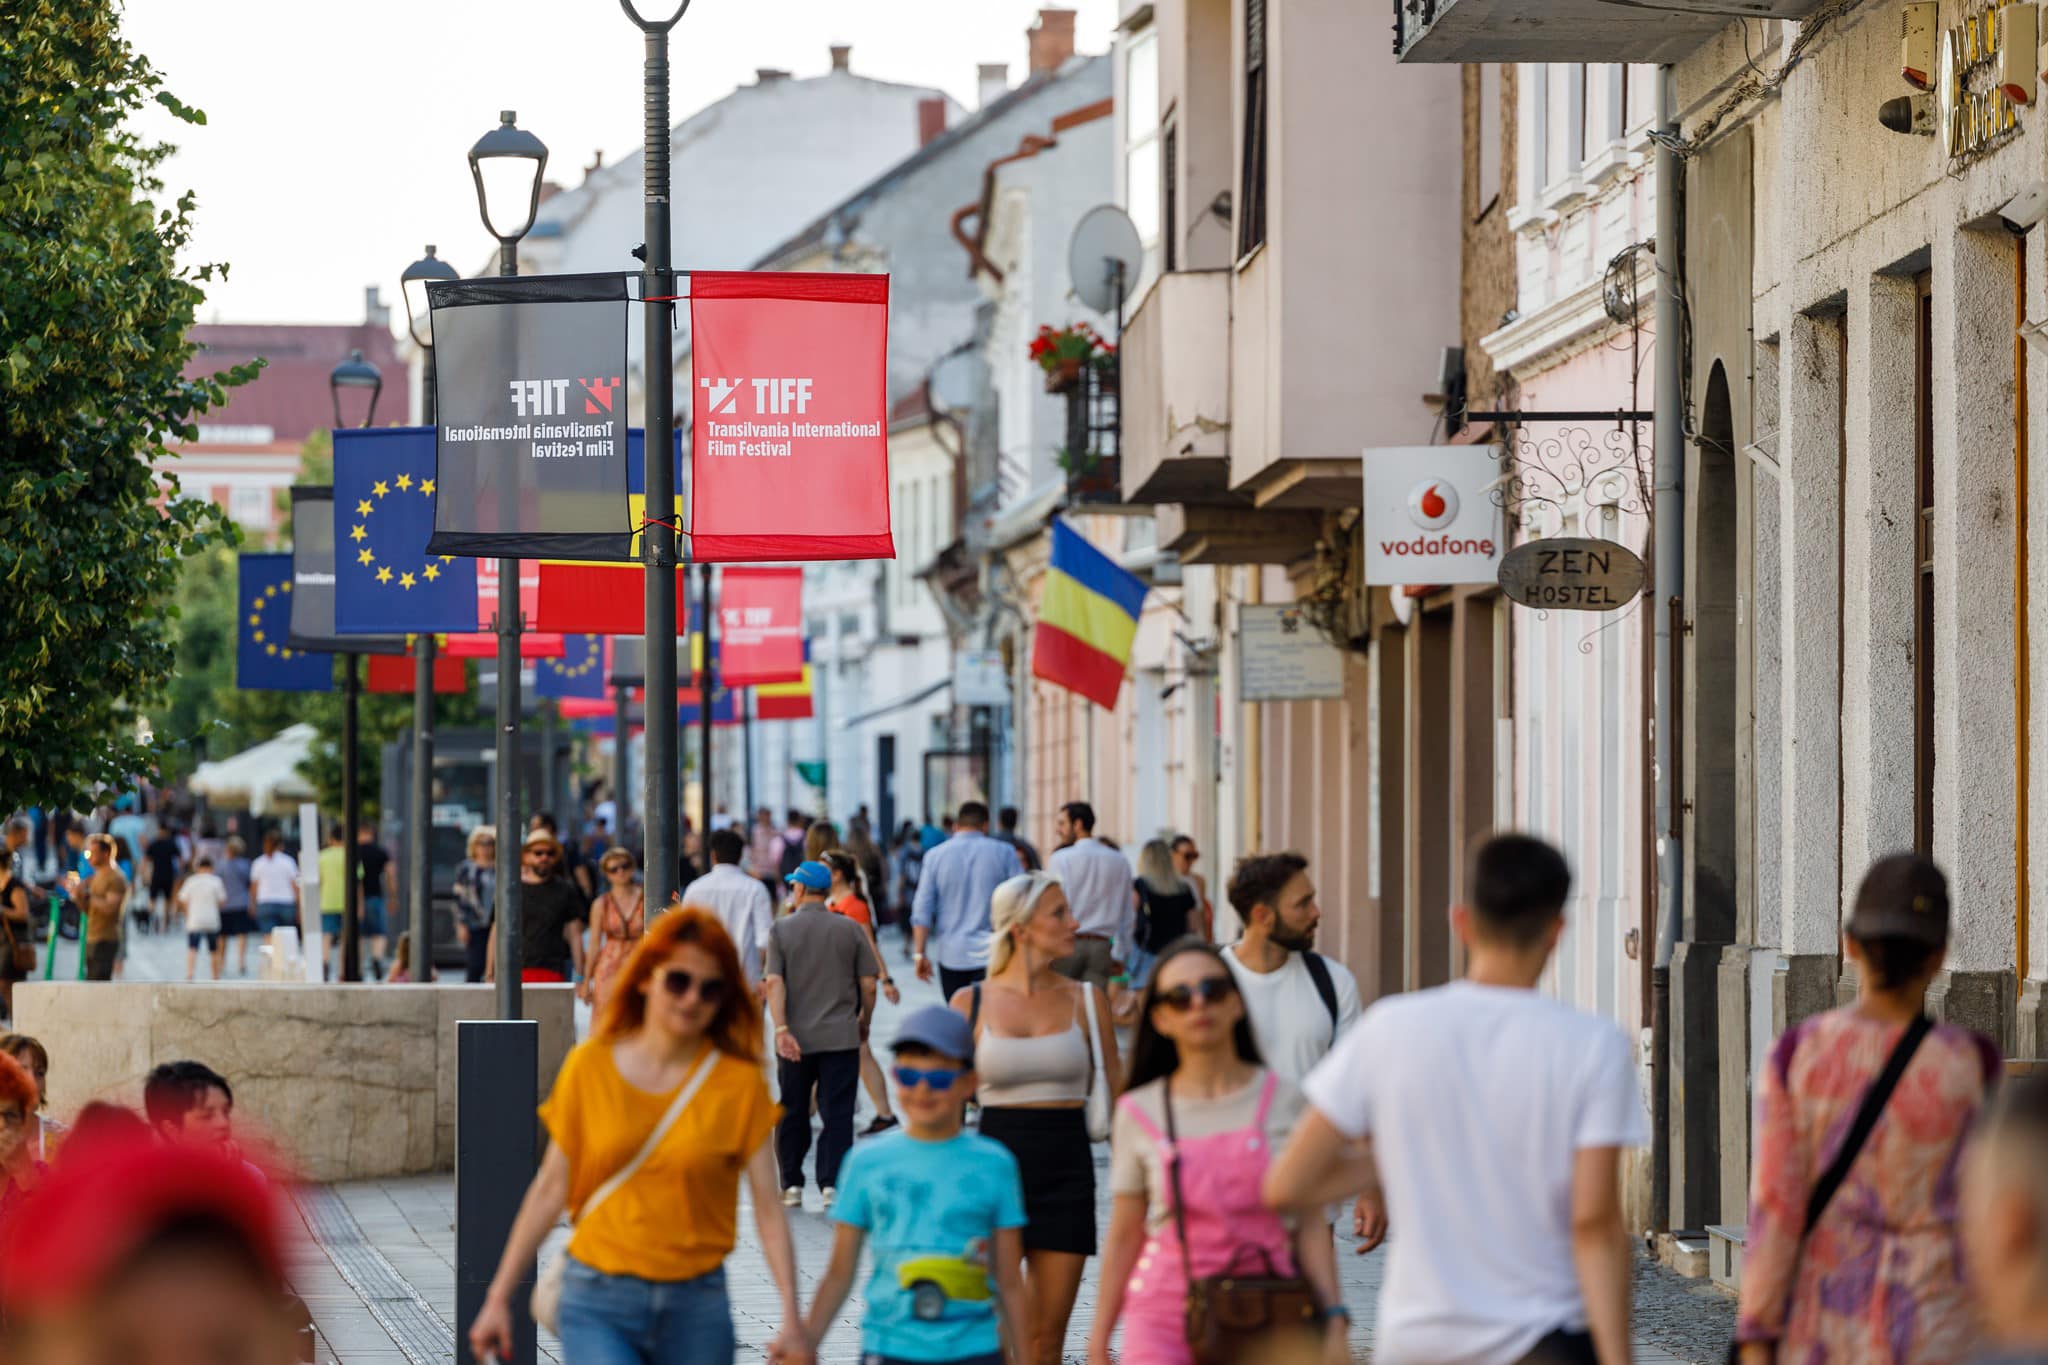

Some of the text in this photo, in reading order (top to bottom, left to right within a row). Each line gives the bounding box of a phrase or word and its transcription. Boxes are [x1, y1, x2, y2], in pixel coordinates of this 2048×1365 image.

[751, 378, 813, 414] TIFF
[707, 420, 881, 438] Transilvania International
[707, 440, 792, 457] Film Festival
[1381, 535, 1493, 557] vodafone
[1536, 550, 1611, 575] ZEN
[1525, 586, 1617, 604] HOSTEL
